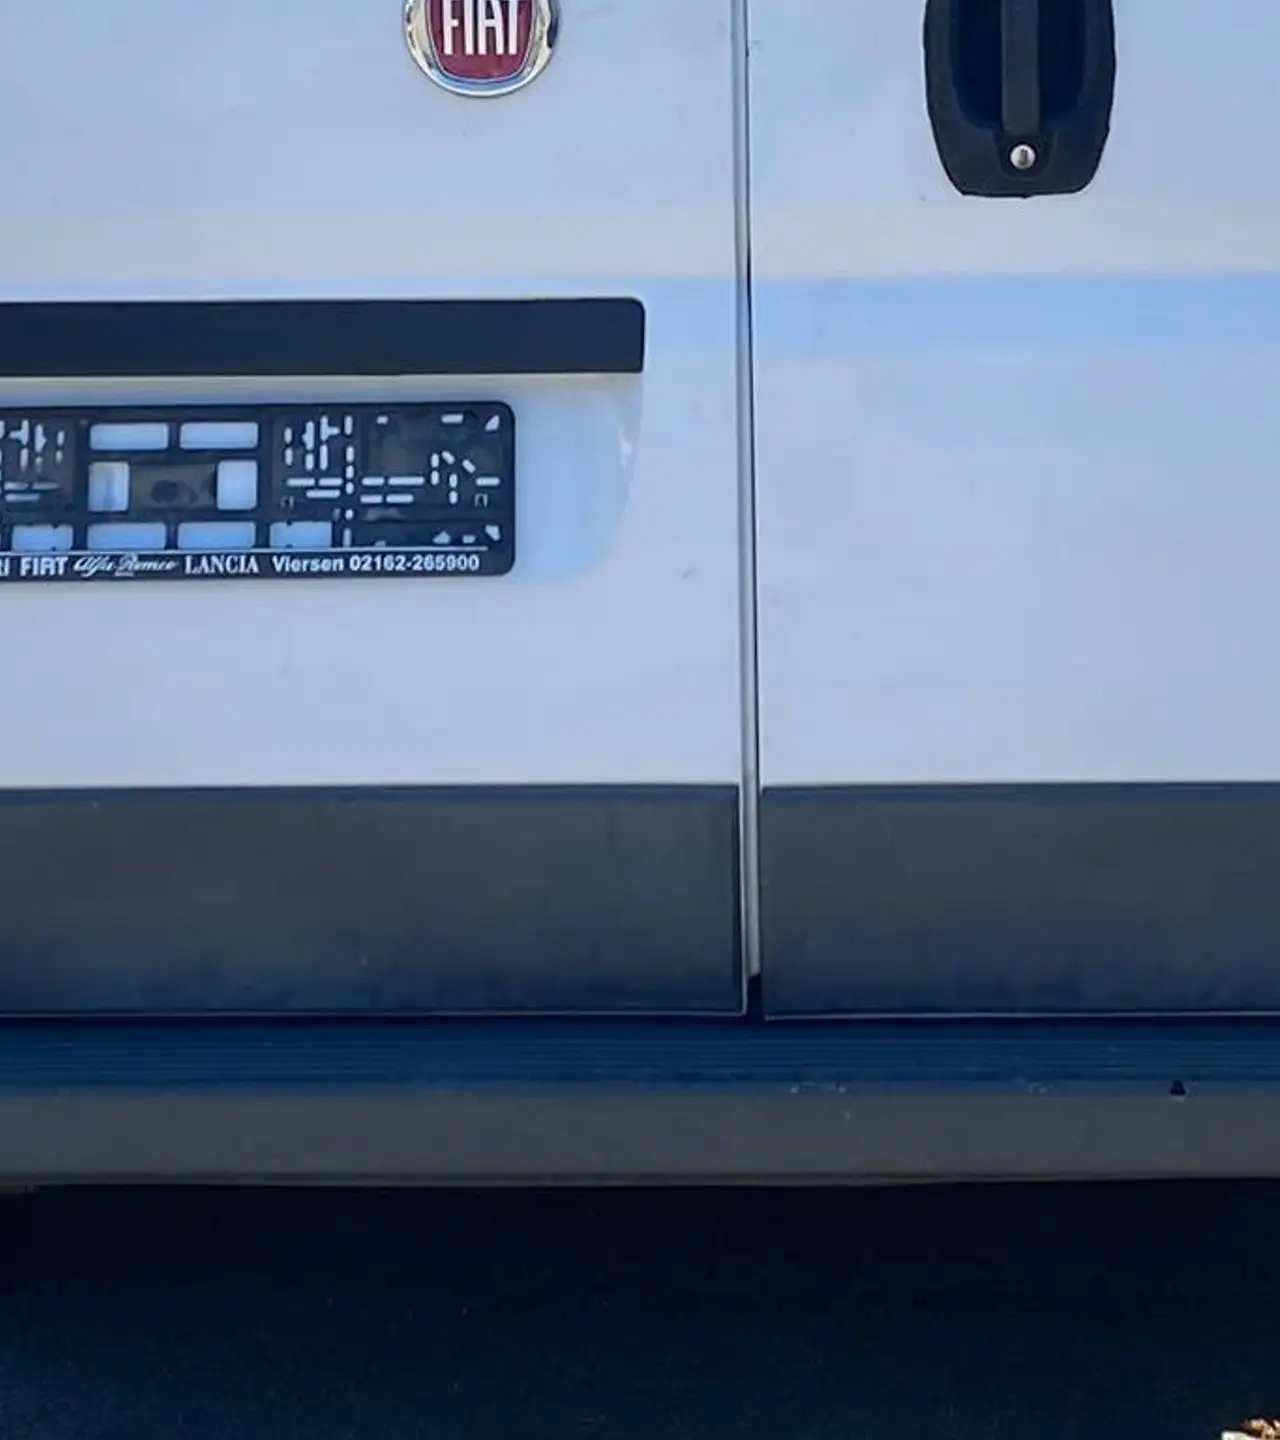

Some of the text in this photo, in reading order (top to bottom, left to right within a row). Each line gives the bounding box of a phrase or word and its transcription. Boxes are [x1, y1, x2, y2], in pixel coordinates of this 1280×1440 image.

[20, 556, 68, 576] FIAT
[184, 554, 260, 574] LANCIA
[272, 554, 344, 573] Viersen
[349, 553, 480, 572] 02162-265900
